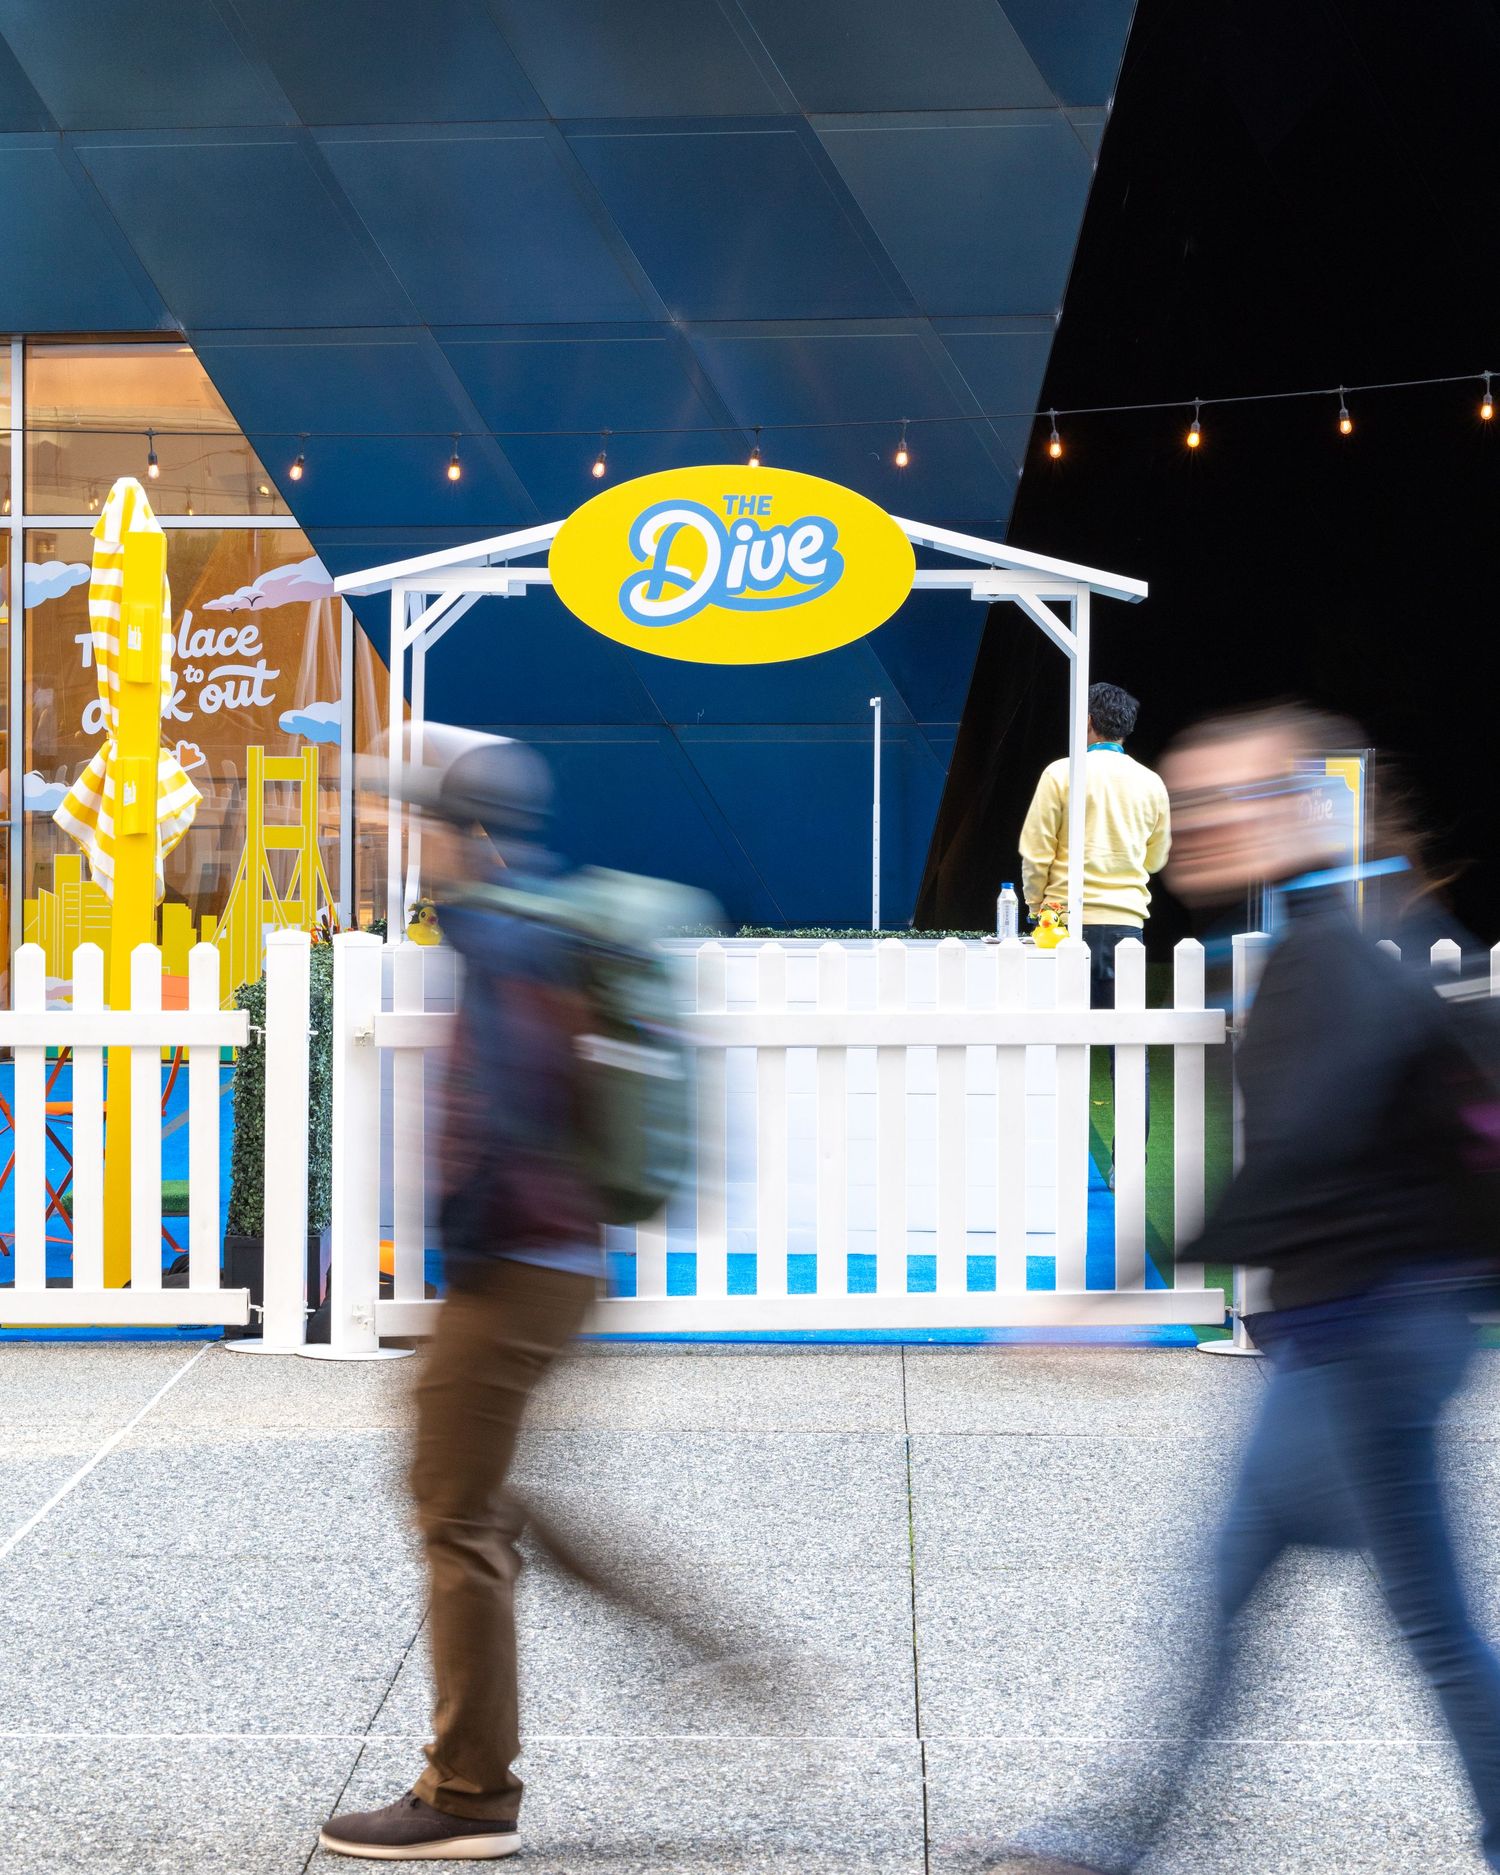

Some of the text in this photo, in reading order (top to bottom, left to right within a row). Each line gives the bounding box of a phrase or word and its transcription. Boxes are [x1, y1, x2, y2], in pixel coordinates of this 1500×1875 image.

[722, 494, 774, 516] THE
[619, 500, 843, 626] Dive
[170, 609, 263, 660] lace
[183, 664, 205, 684] to
[198, 659, 281, 715] out
